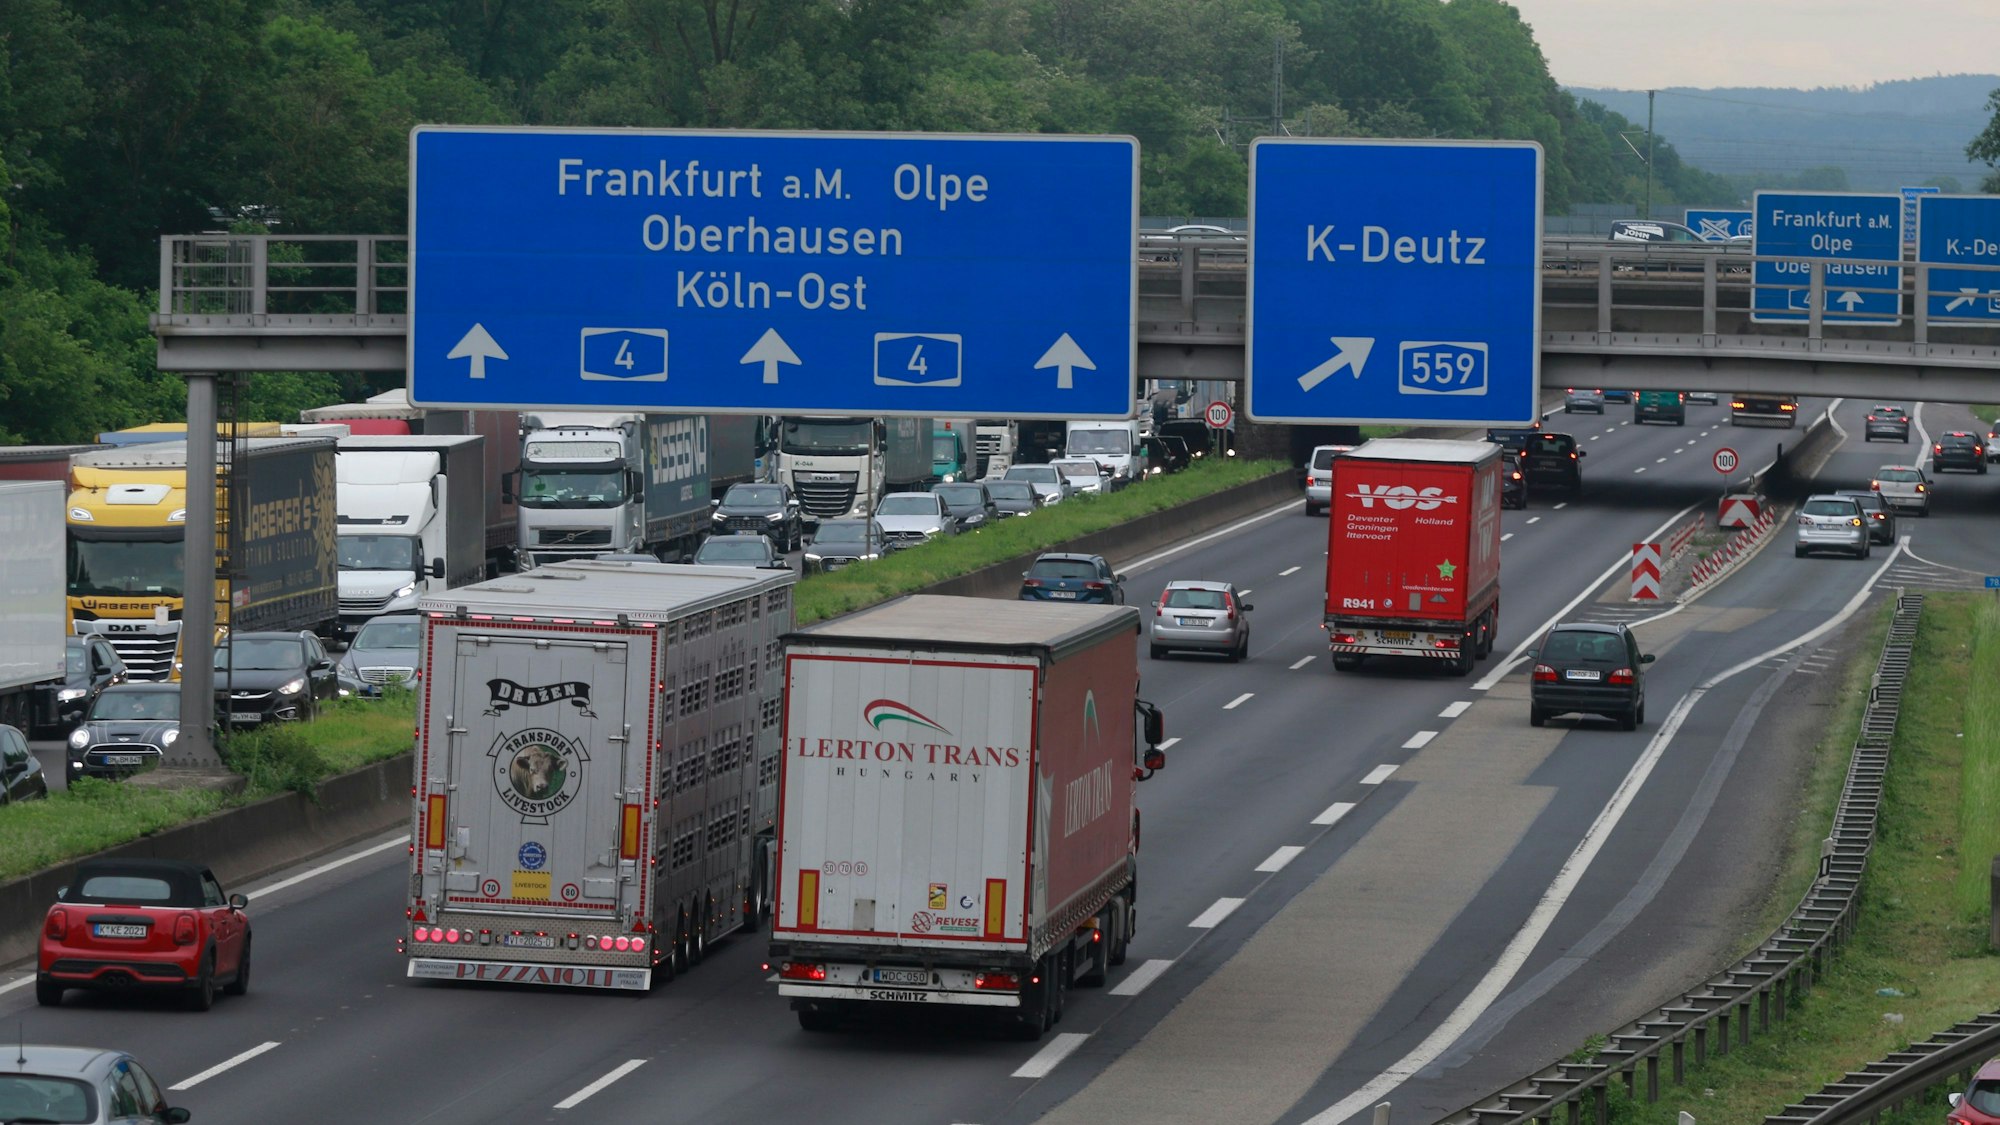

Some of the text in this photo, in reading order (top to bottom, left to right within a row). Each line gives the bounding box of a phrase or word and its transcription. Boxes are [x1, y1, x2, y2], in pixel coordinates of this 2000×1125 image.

[557, 158, 989, 211] Frankfurt a.M. Olpe
[1772, 210, 1892, 229] Frankfurt a.M.
[642, 214, 902, 256] Oberhausen
[1306, 224, 1486, 265] K-Deutz
[1811, 234, 1853, 255] Olpe
[1946, 239, 2000, 256] K.-De
[676, 271, 867, 312] Köln-Ost
[614, 339, 634, 371] 4
[907, 344, 928, 376] 4
[1412, 352, 1475, 385] 559
[1211, 409, 1226, 421] 100
[1718, 455, 1734, 467] 100
[1356, 484, 1443, 511] VOS
[1346, 523, 1399, 533] Groningen
[1347, 514, 1454, 526] Deventer Holland
[1346, 532, 1392, 540] Ittervoort
[1402, 585, 1455, 593] vosdeventer.com
[1343, 598, 1375, 609] R941
[1376, 638, 1414, 646] SCHMITZ
[498, 682, 576, 704] DRAŽEN
[506, 732, 573, 756] TRANSPORT
[798, 737, 1020, 768] LERTON TRANS
[502, 788, 570, 813] LIVESTOCK
[487, 884, 496, 892] 70
[124, 926, 145, 935] 2021
[936, 917, 979, 927] REVESZ
[870, 990, 927, 1001] SCHMITZ
